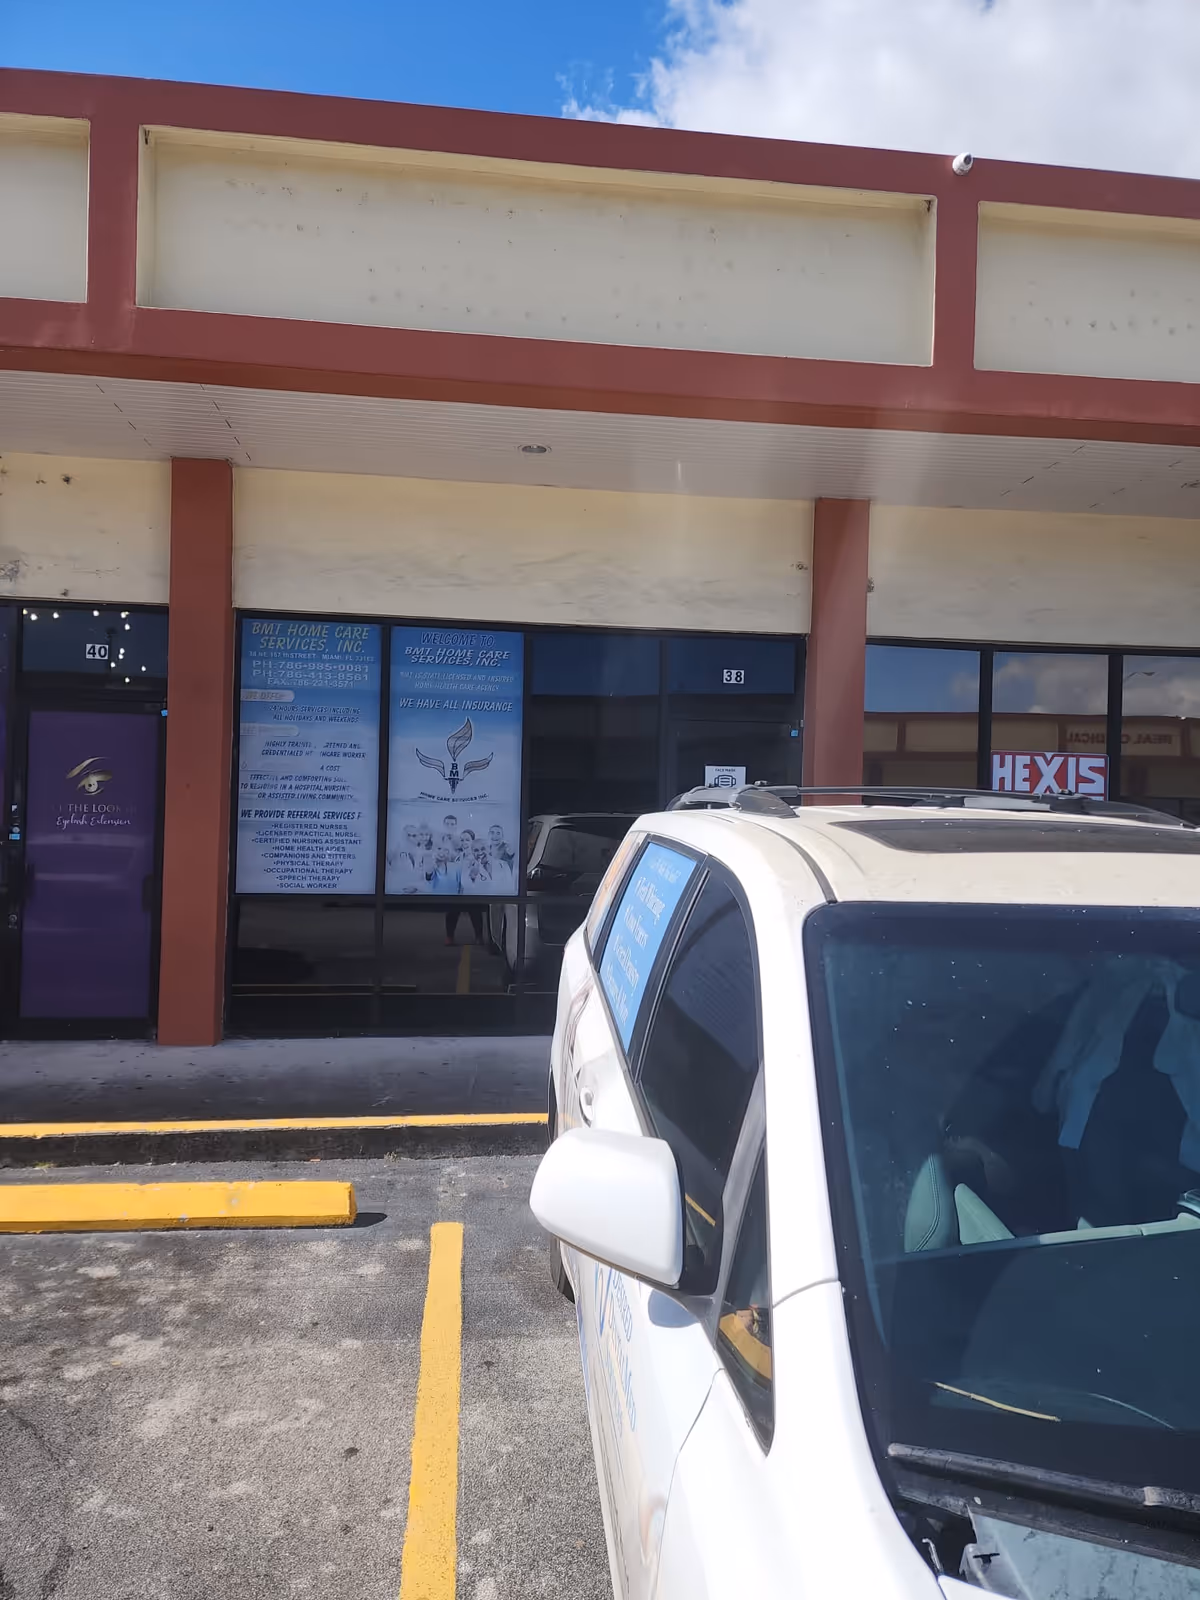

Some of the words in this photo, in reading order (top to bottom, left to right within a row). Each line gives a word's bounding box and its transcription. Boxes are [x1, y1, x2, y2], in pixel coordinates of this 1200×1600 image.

[252, 622, 282, 635] BMT
[288, 624, 330, 638] HOME
[335, 626, 370, 640] CARE
[259, 636, 329, 653] SERVICES,
[337, 640, 365, 653] INC.
[421, 632, 477, 646] WELCOME
[480, 635, 495, 647] TO
[87, 644, 108, 659] 40
[405, 647, 432, 655] BMT
[437, 648, 473, 658] HOME
[478, 650, 511, 660] CARE
[411, 656, 473, 667] SERVICES,
[475, 658, 501, 667] INC.
[724, 670, 743, 683] 38
[329, 707, 361, 715] INCLUDING
[399, 698, 415, 708] WE
[416, 698, 441, 709] HAVE
[443, 700, 458, 710] ALL
[462, 700, 513, 712] INSURANCE
[285, 714, 313, 722] HOLIDAYS
[261, 749, 304, 757] CREDENTIALED
[992, 754, 1104, 794] HEXIS
[67, 803, 89, 813] THE
[241, 809, 253, 818] WE
[254, 809, 285, 819] PROVIDE
[287, 810, 320, 819] REFERRAL
[323, 811, 355, 820] SERVICES
[56, 813, 88, 830] Eyelash
